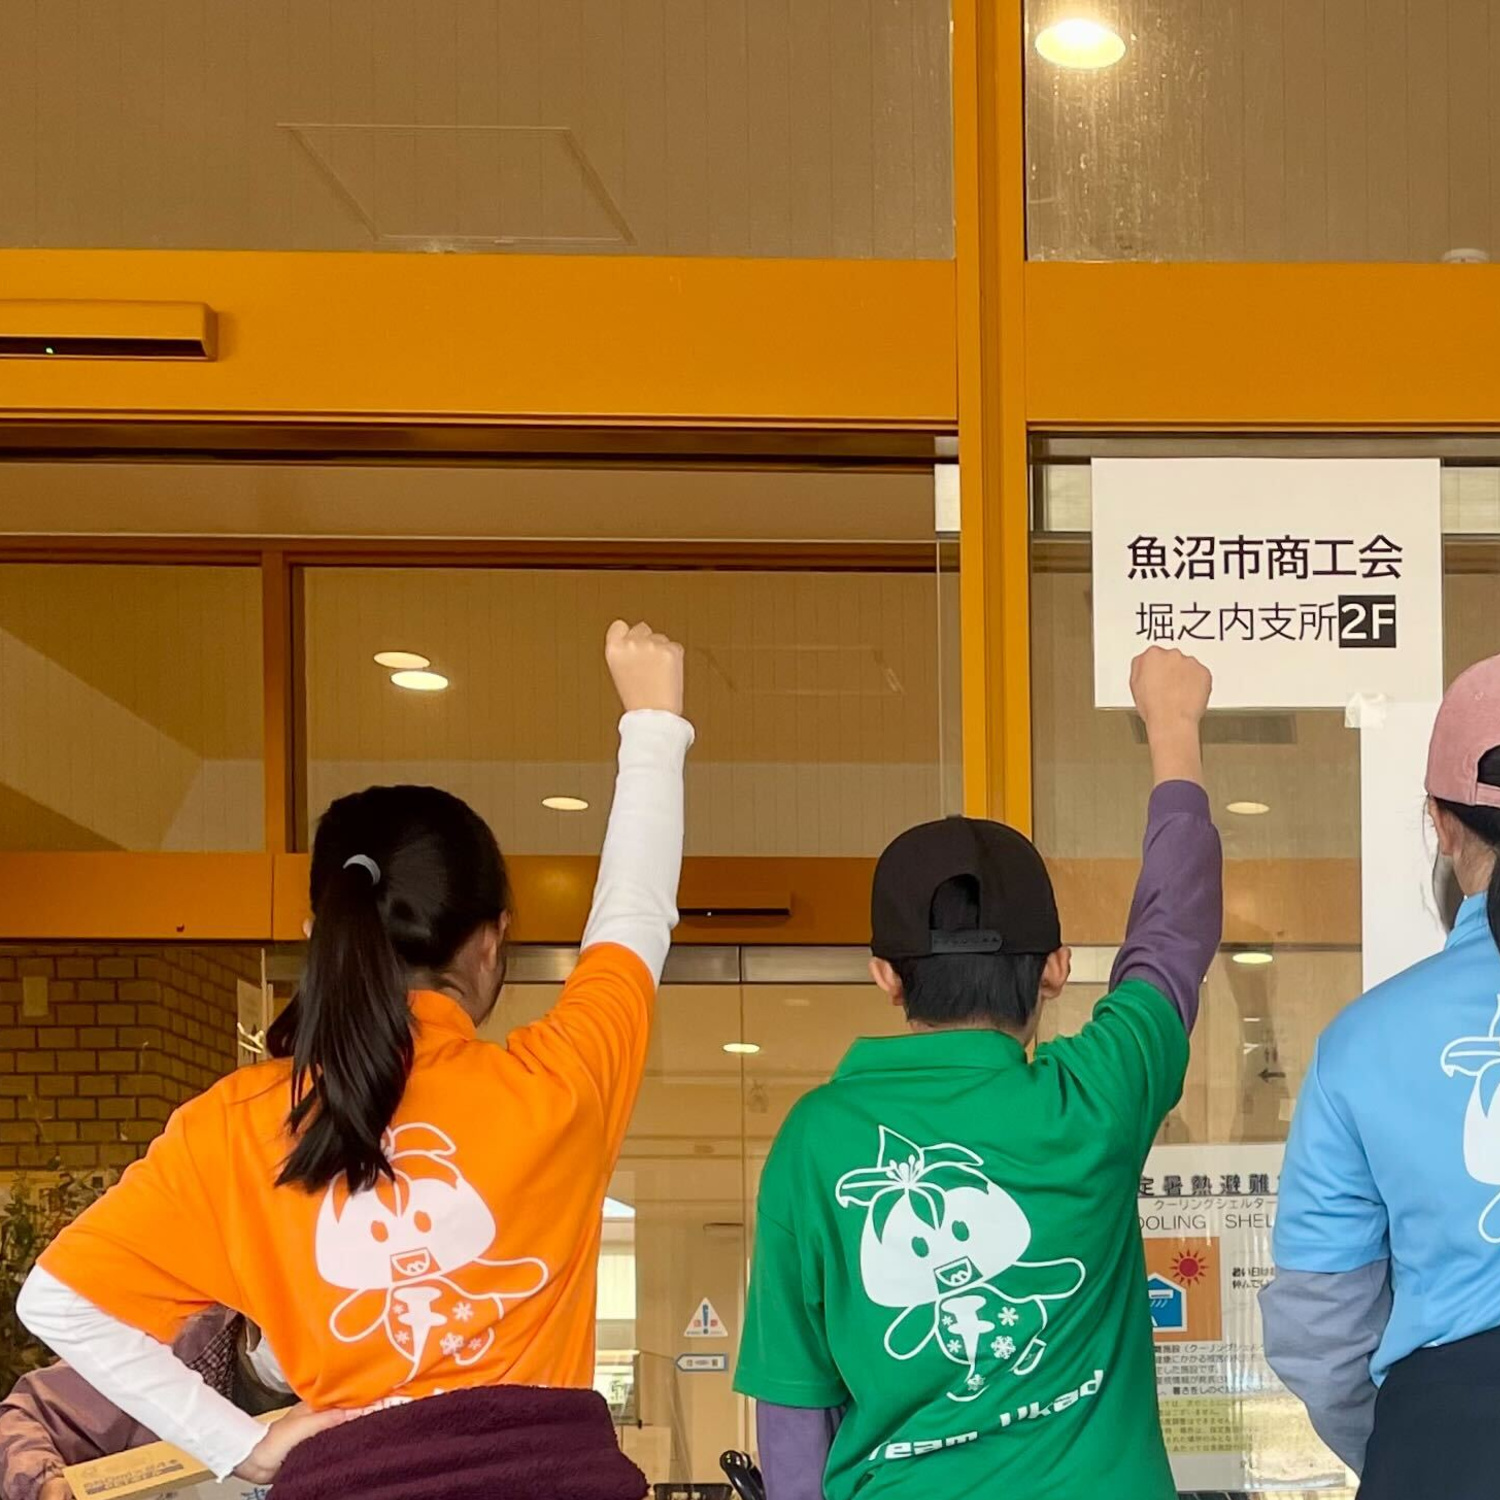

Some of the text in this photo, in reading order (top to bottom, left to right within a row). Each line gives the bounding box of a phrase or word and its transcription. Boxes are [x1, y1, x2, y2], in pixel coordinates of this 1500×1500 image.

[1126, 534, 1404, 581] 魚沼市商工会
